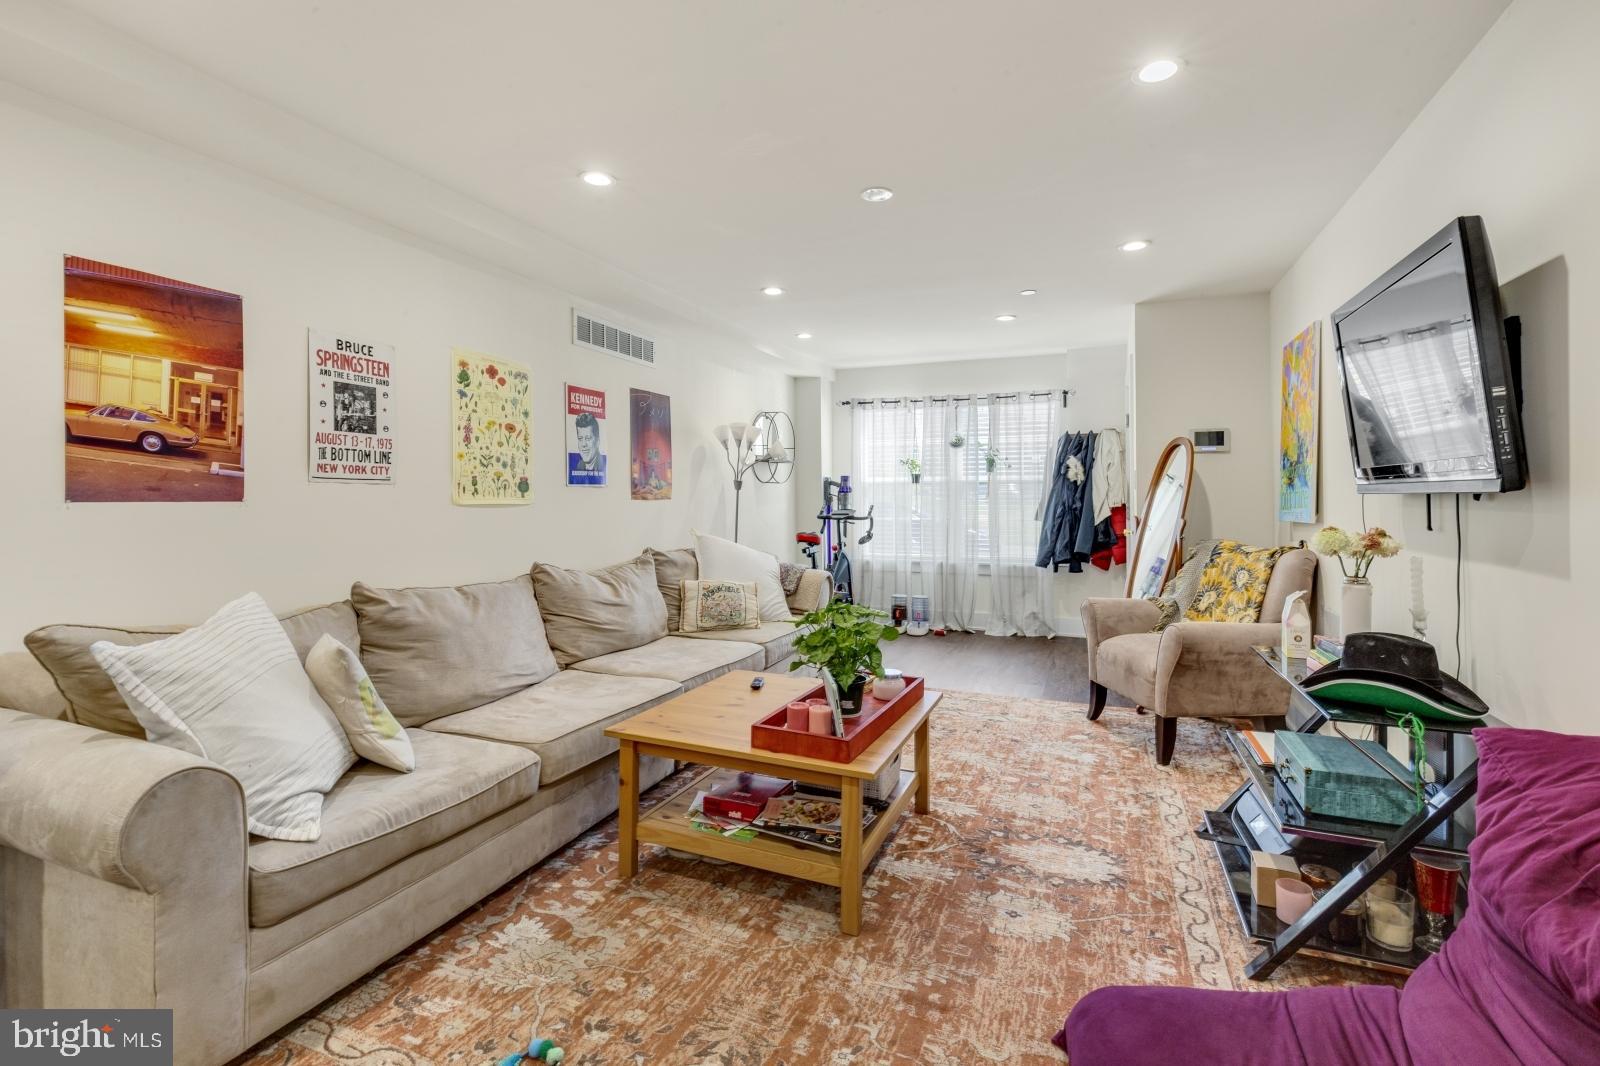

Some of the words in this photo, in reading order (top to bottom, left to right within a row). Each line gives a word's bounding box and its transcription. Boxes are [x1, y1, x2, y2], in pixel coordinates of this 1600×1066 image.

[336, 338, 374, 357] BRUCE
[315, 348, 390, 378] SPRINGSTEEN
[319, 368, 332, 377] AND
[333, 370, 345, 379] THE
[353, 374, 374, 385] STREET
[375, 378, 390, 387] BAND
[570, 391, 603, 408] KENNEDY
[570, 403, 581, 411] FOR
[315, 431, 349, 446] AUGUST
[376, 437, 393, 450] 1975
[330, 446, 372, 464] BOTTOM
[373, 450, 392, 465] LINE
[316, 463, 339, 474] NEW
[341, 464, 368, 475] YORK
[370, 465, 390, 476] CITY
